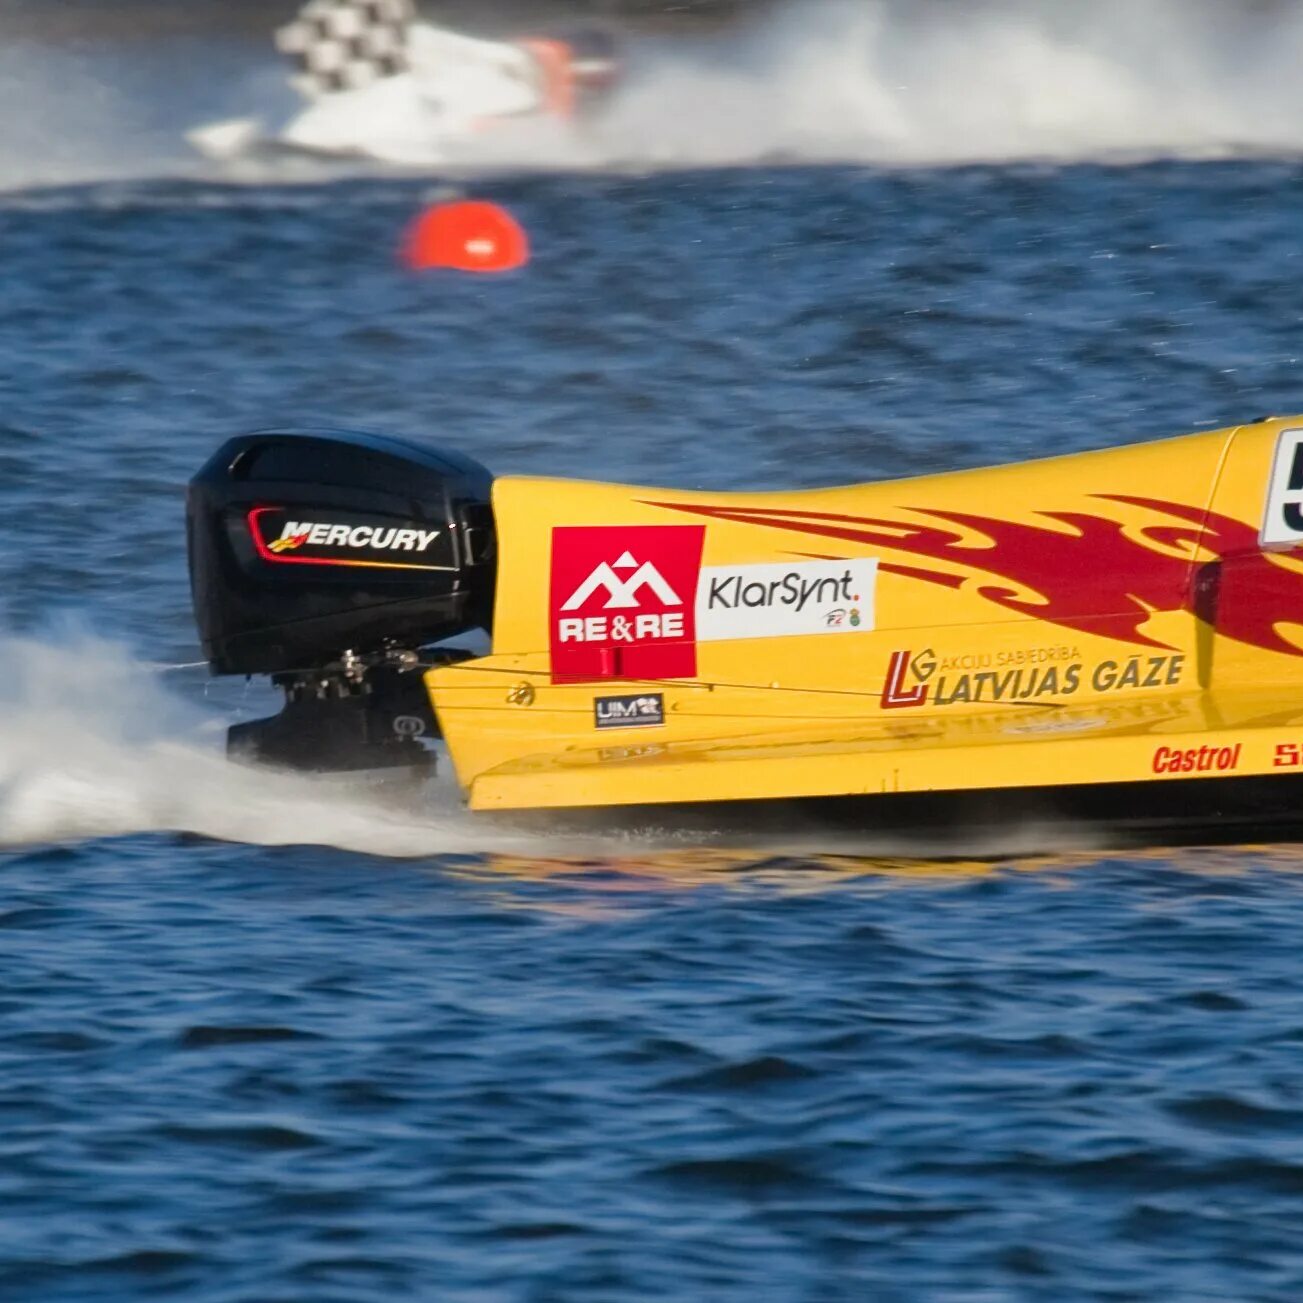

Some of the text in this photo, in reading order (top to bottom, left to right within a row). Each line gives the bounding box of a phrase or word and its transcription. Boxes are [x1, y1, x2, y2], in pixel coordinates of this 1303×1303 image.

[272, 521, 440, 551] MERCURY
[708, 570, 860, 612] KlarSynt.
[933, 654, 1186, 705] LATVIJAS GĀZE
[1152, 743, 1243, 774] Castrol
